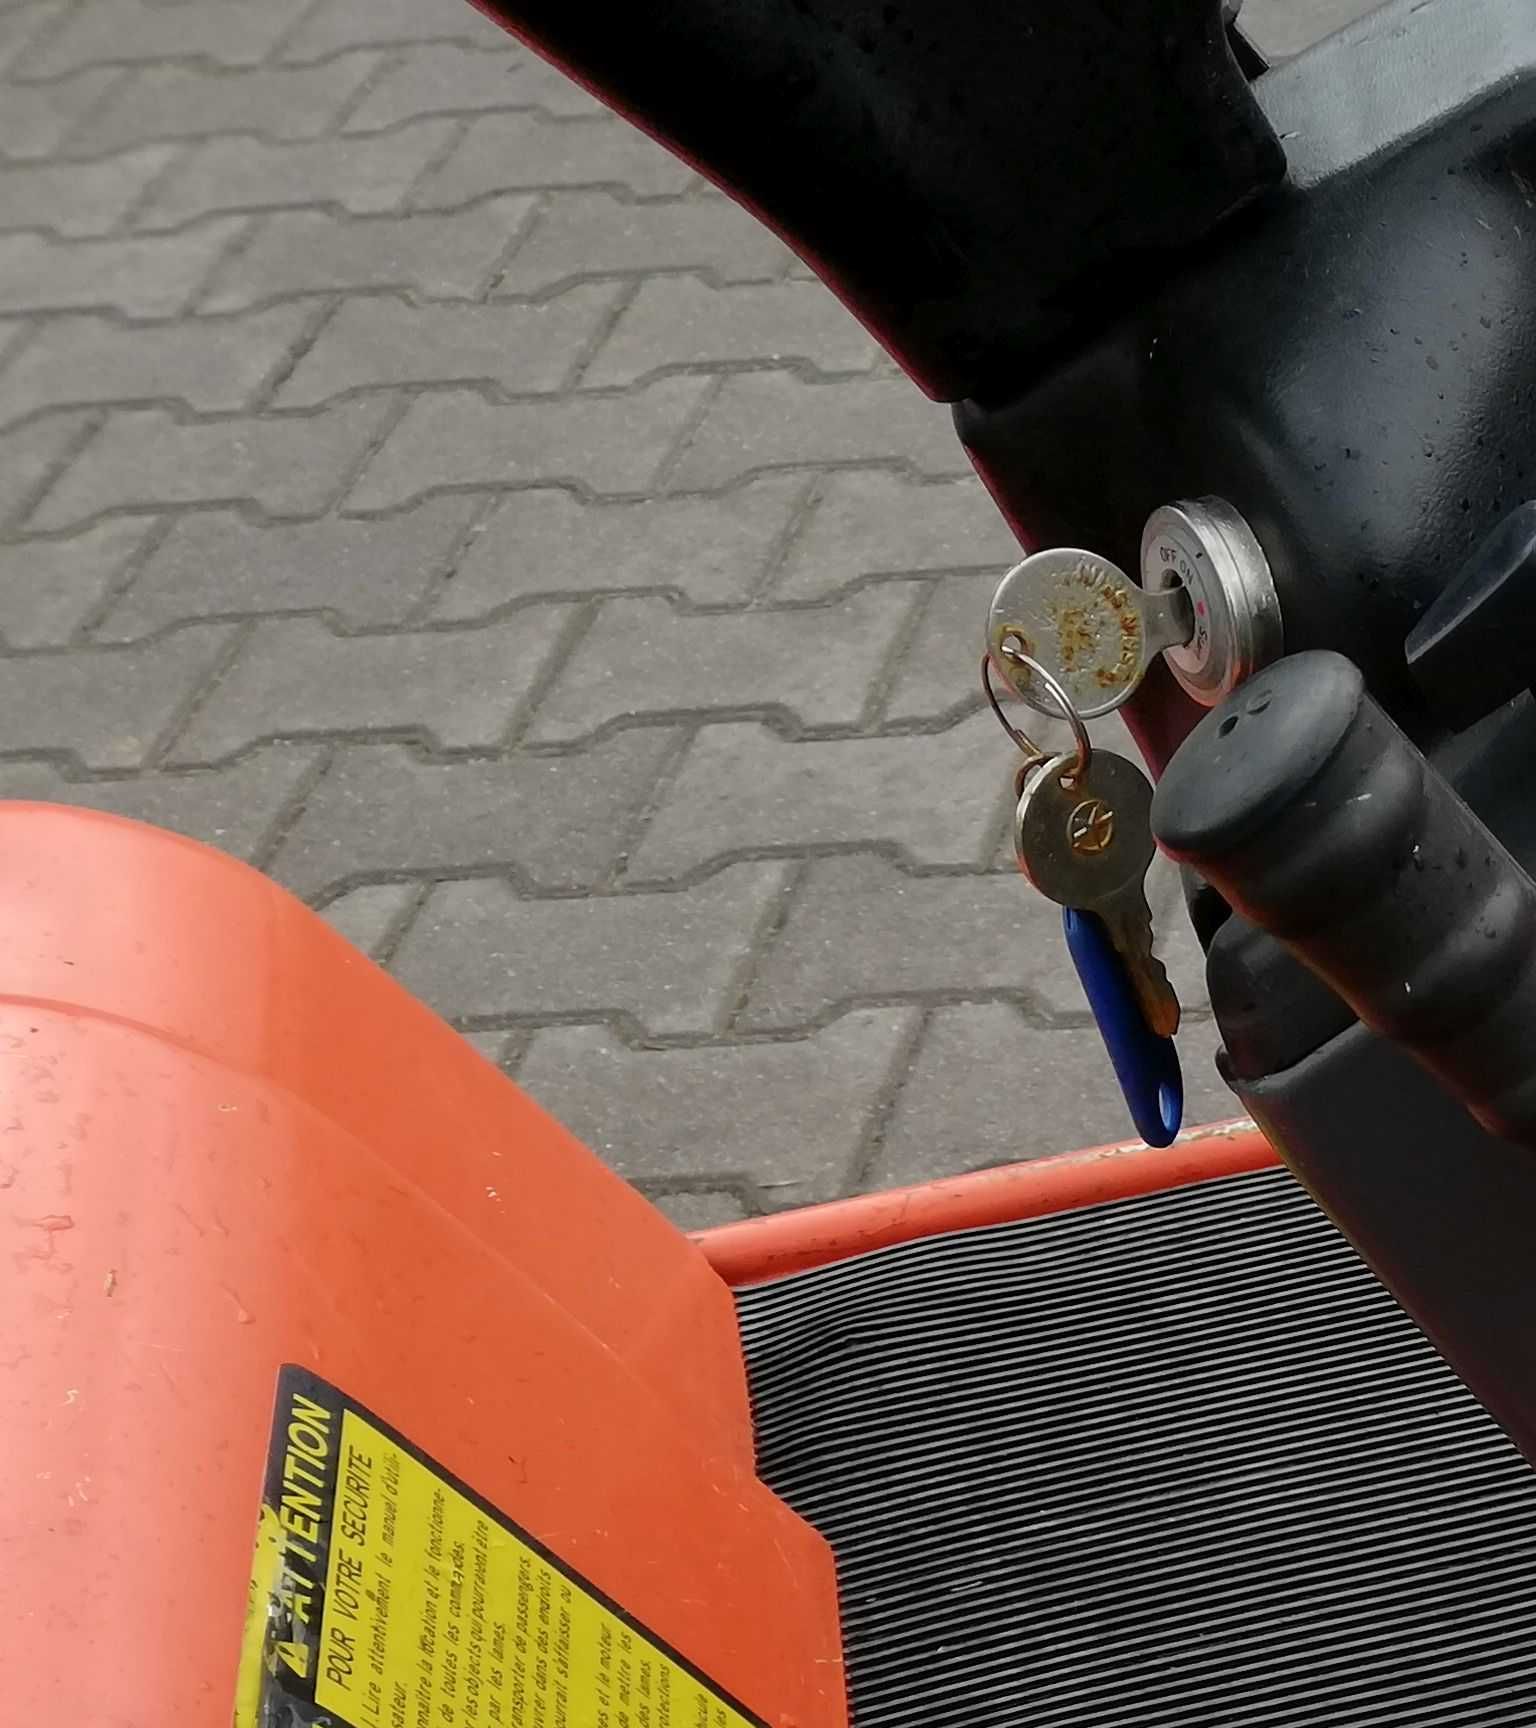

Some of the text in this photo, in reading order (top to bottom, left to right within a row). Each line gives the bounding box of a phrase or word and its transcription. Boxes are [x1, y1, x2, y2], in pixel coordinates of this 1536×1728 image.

[1159, 545, 1177, 563] OFF
[273, 1393, 333, 1628] ATTENTION
[381, 1488, 397, 1545] manuel
[326, 1445, 372, 1690] POUR VOTRE SECURITE
[423, 1564, 440, 1580] le
[423, 1579, 440, 1599] et
[442, 1621, 460, 1646] les
[439, 1649, 457, 1698] toutes
[438, 1703, 454, 1723] de
